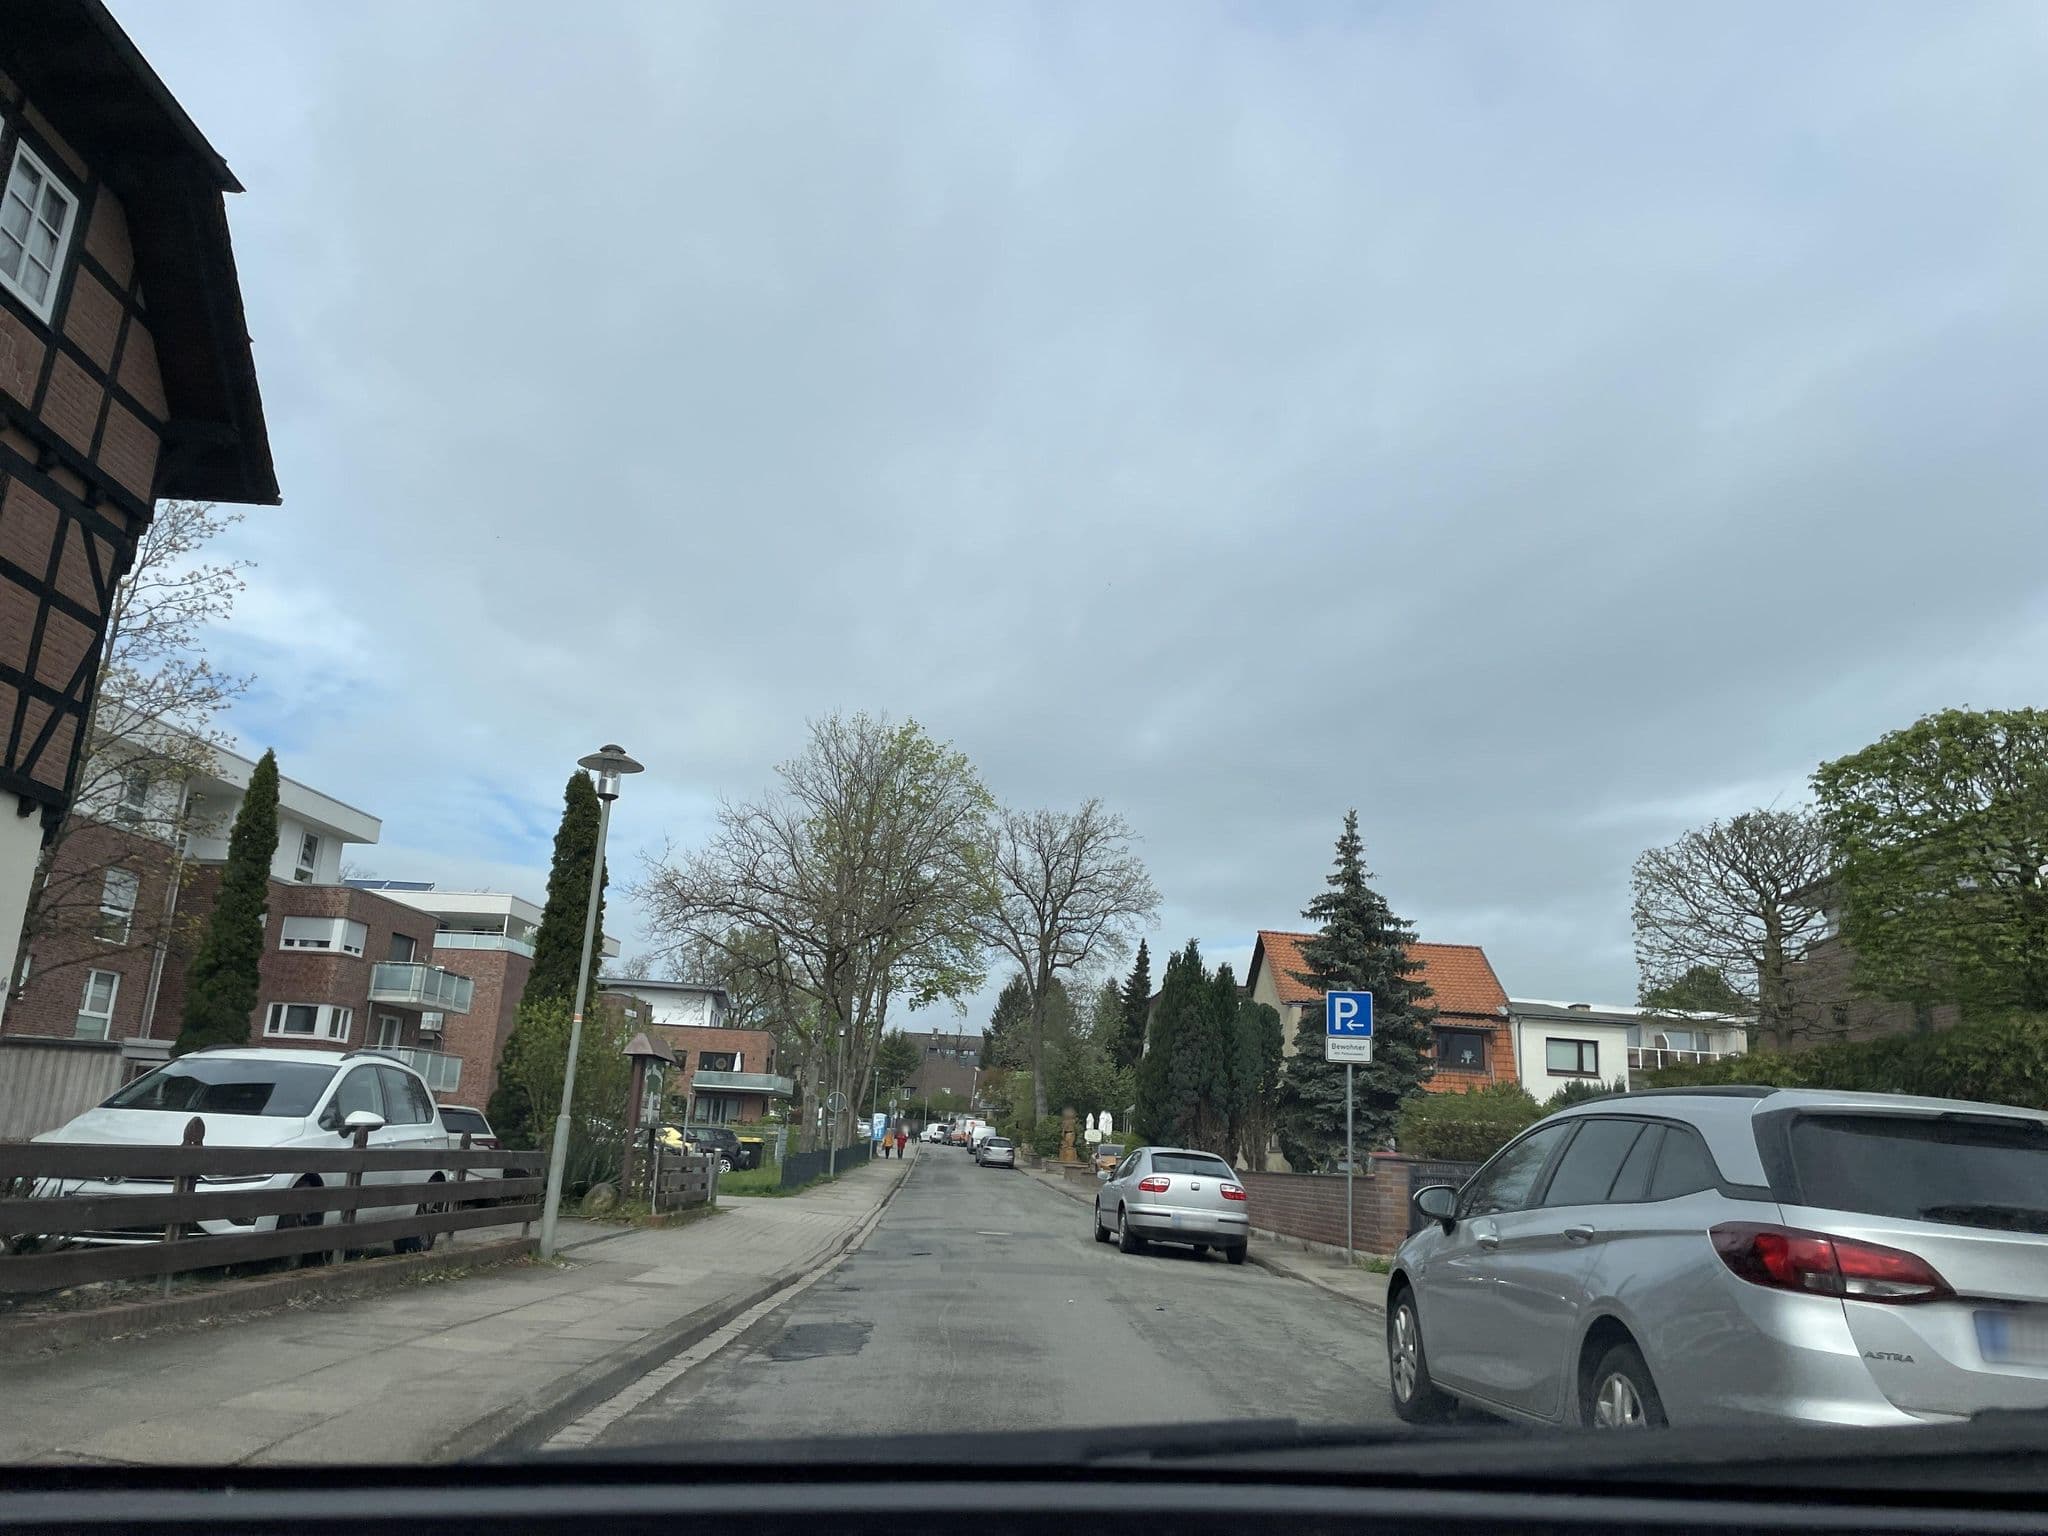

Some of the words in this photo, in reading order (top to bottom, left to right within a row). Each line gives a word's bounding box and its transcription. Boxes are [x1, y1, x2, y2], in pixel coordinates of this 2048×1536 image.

[1335, 998, 1358, 1030] P
[1331, 1042, 1366, 1051] Bewohner
[1864, 1351, 1914, 1364] ASTRA
